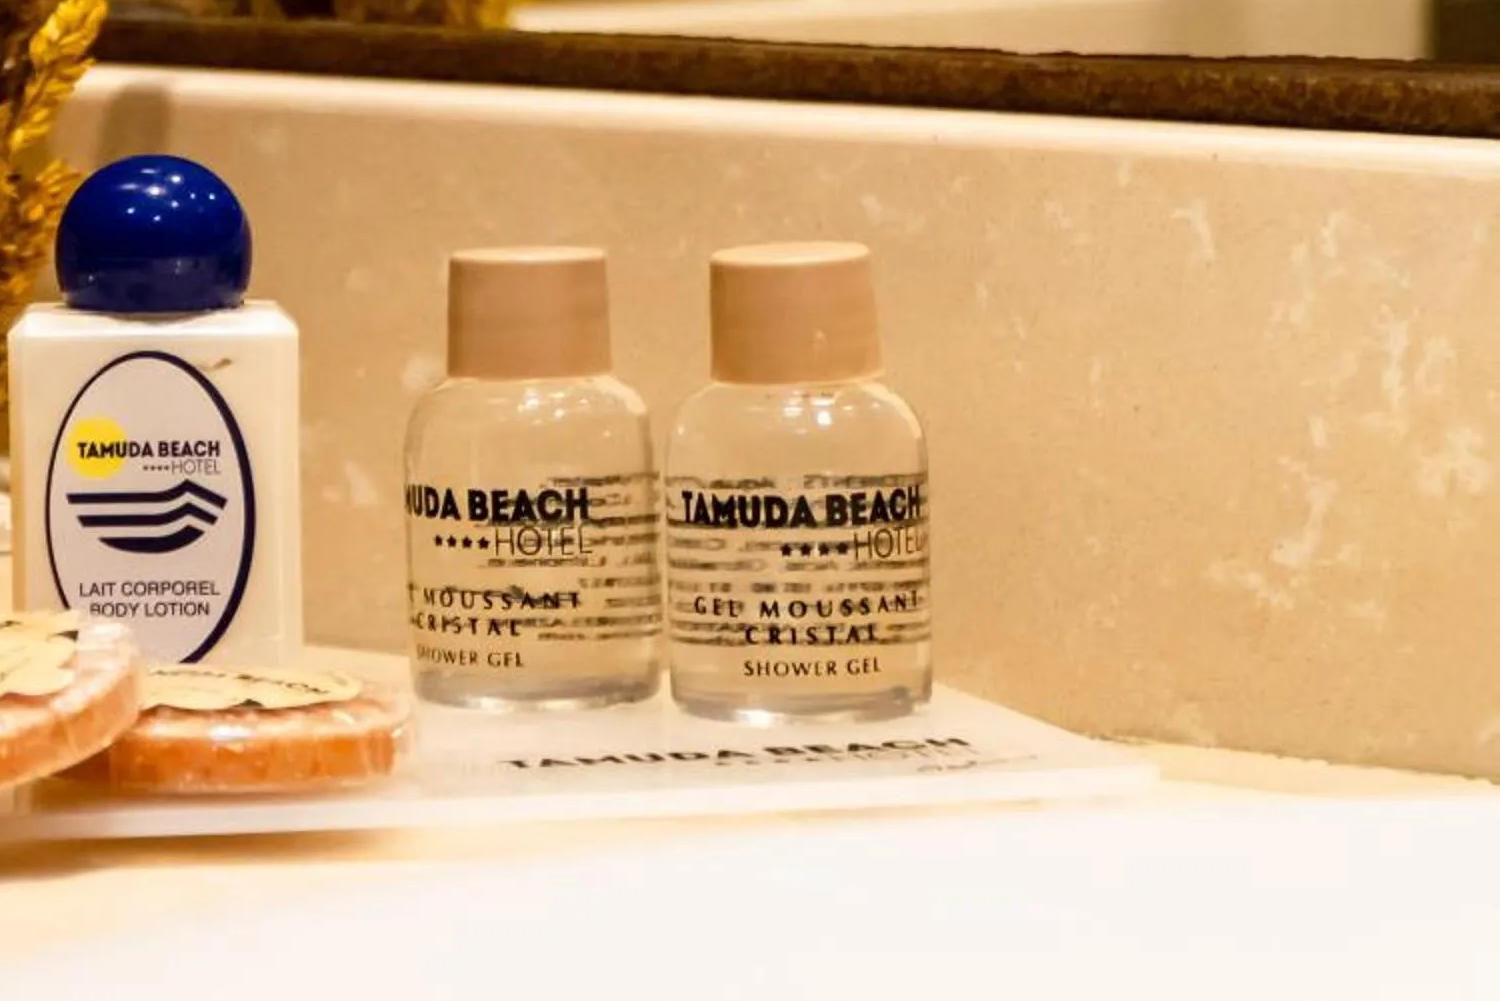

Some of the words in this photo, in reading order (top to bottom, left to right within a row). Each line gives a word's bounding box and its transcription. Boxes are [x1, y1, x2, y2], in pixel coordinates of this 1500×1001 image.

[77, 441, 154, 459] TAMUDA
[158, 440, 220, 458] BEACH
[171, 459, 221, 475] HOTEL
[467, 487, 589, 522] BEACH
[681, 491, 818, 529] TAMUDA
[825, 485, 921, 527] BEACH
[495, 525, 593, 556] HOTEL
[79, 582, 116, 598] LAIT
[121, 580, 220, 596] CORPOREL
[423, 586, 581, 610] MOUSSANT
[90, 603, 139, 618] BODY
[145, 602, 210, 617] LOTION
[693, 596, 738, 617] GEL
[759, 590, 919, 618] MOUSSANT
[417, 612, 522, 637] CRISTAL
[744, 624, 878, 646] CRISTAL
[487, 651, 524, 668] GEL
[744, 659, 837, 677] SHOWER
[846, 656, 882, 674] GEL
[502, 750, 754, 769] TAMUDA
[763, 737, 972, 756] BEACH
